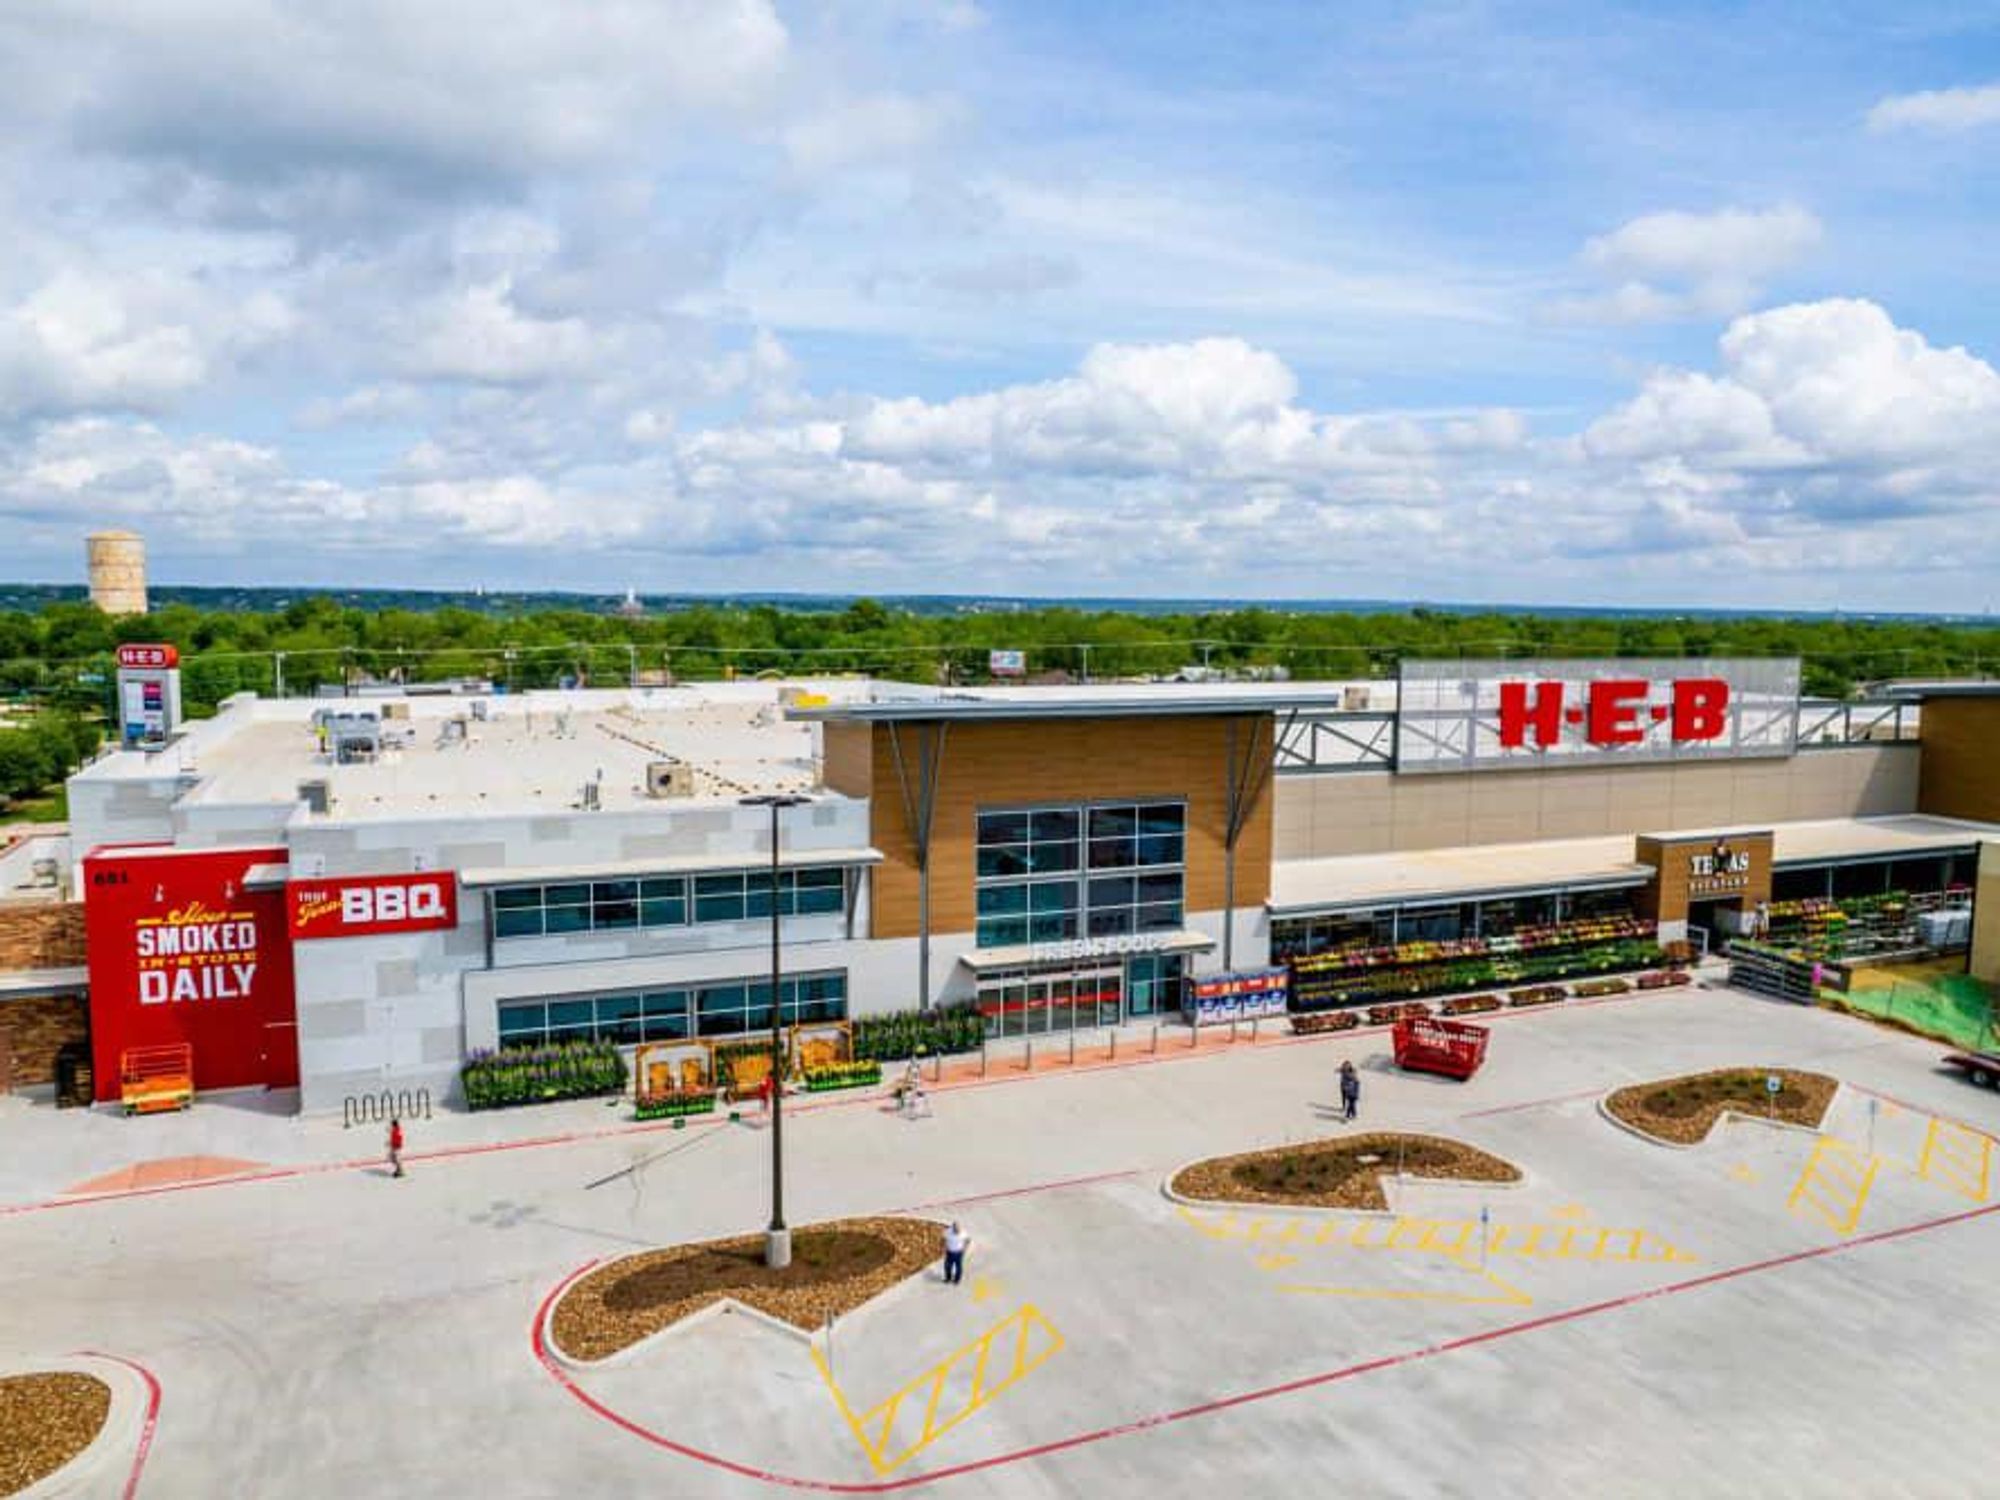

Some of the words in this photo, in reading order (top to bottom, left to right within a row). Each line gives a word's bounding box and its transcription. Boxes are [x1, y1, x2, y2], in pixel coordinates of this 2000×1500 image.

[341, 883, 448, 922] BBQ
[137, 921, 257, 957] SMOKED
[139, 964, 257, 1004] DAILY
